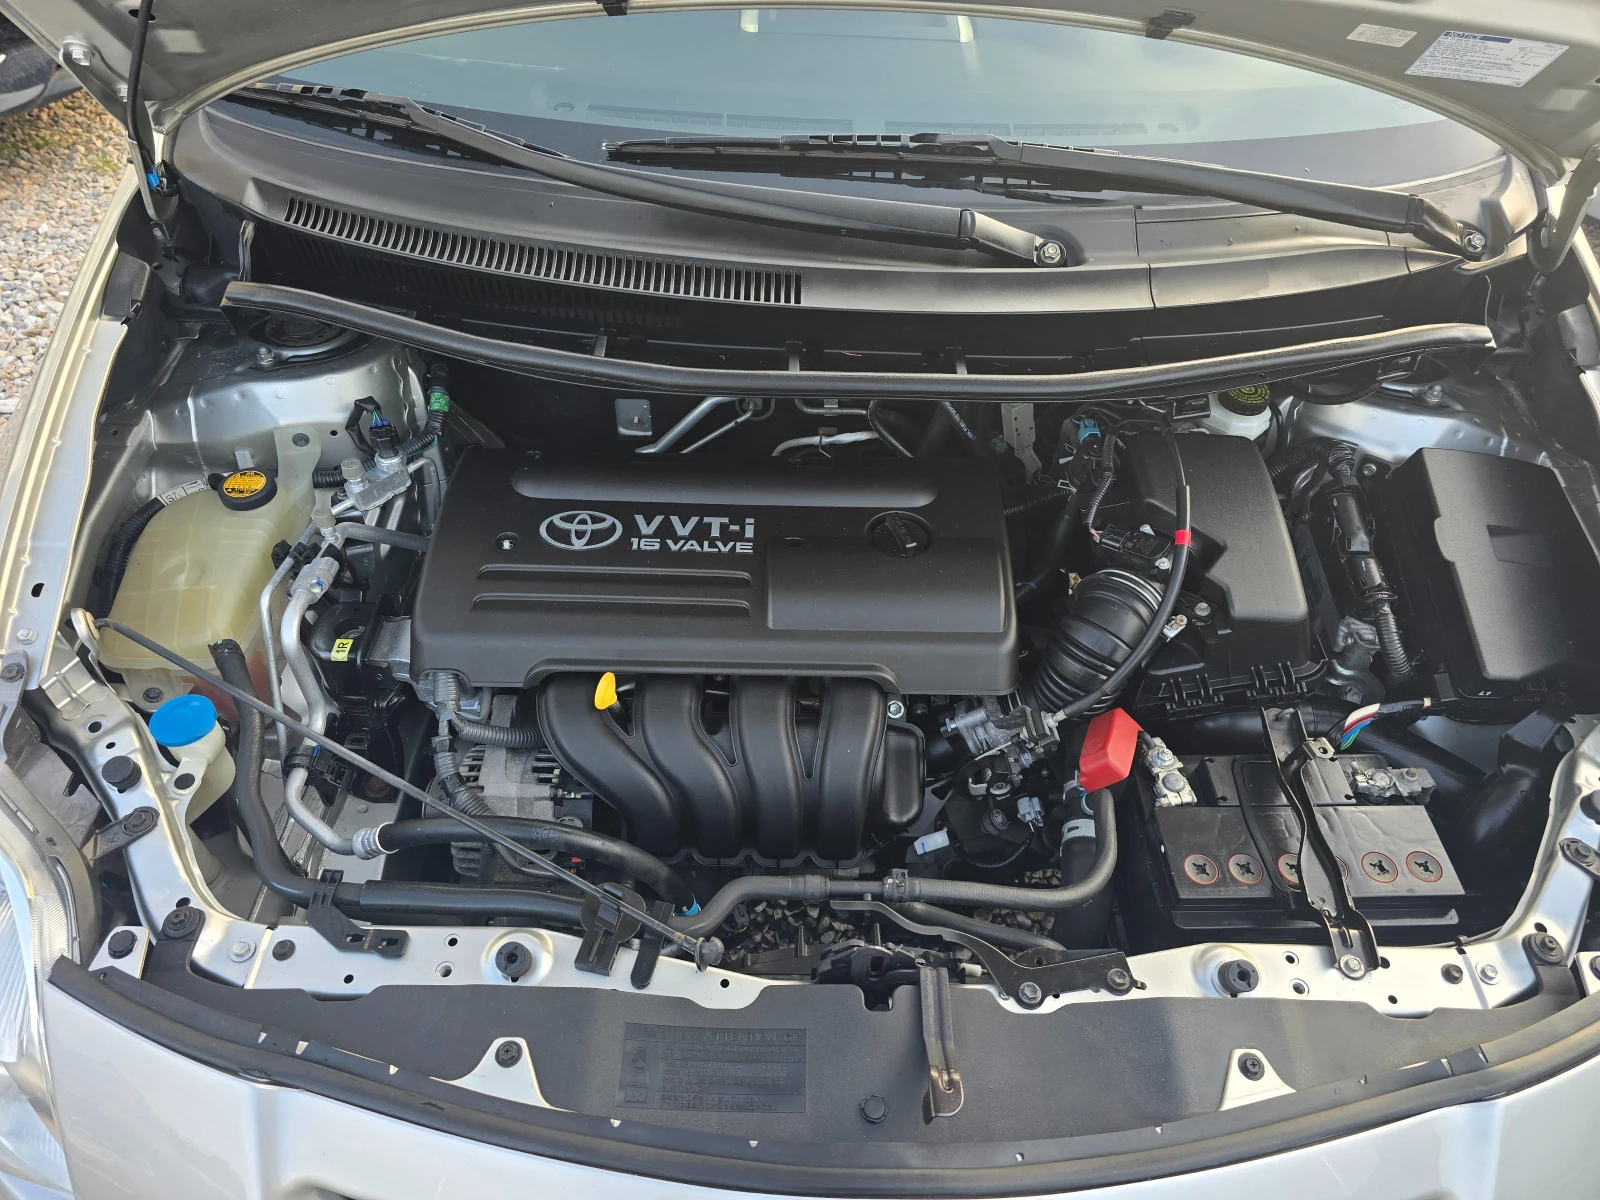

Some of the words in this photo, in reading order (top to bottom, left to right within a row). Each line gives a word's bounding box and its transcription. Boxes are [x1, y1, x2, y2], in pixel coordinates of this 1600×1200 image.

[634, 514, 755, 539] VVT-i
[630, 537, 660, 551] 16
[666, 539, 753, 554] VALVE
[704, 1031, 777, 1043] ATTENTION
